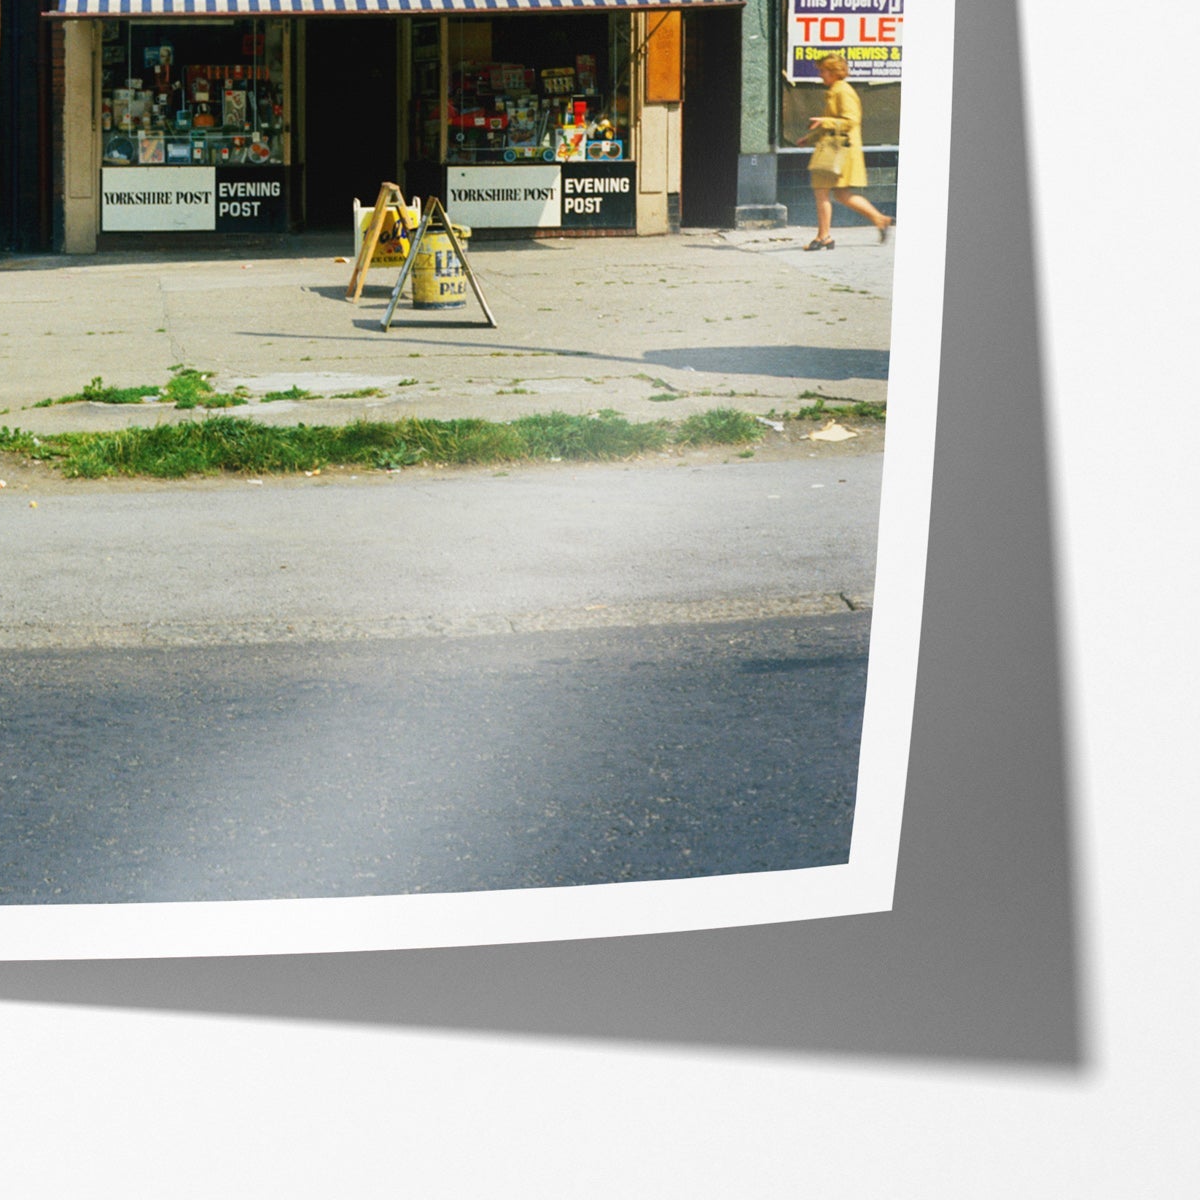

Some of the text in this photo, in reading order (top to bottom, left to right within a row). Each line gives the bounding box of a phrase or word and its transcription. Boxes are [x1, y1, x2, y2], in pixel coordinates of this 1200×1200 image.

[796, 17, 844, 42] TO
[890, 47, 900, 60] &
[105, 182, 280, 205] YORKSHIRE POST EVENING
[451, 177, 630, 202] YORKSHIRE POST EVENING
[219, 202, 261, 217] POST
[565, 197, 603, 214] POST
